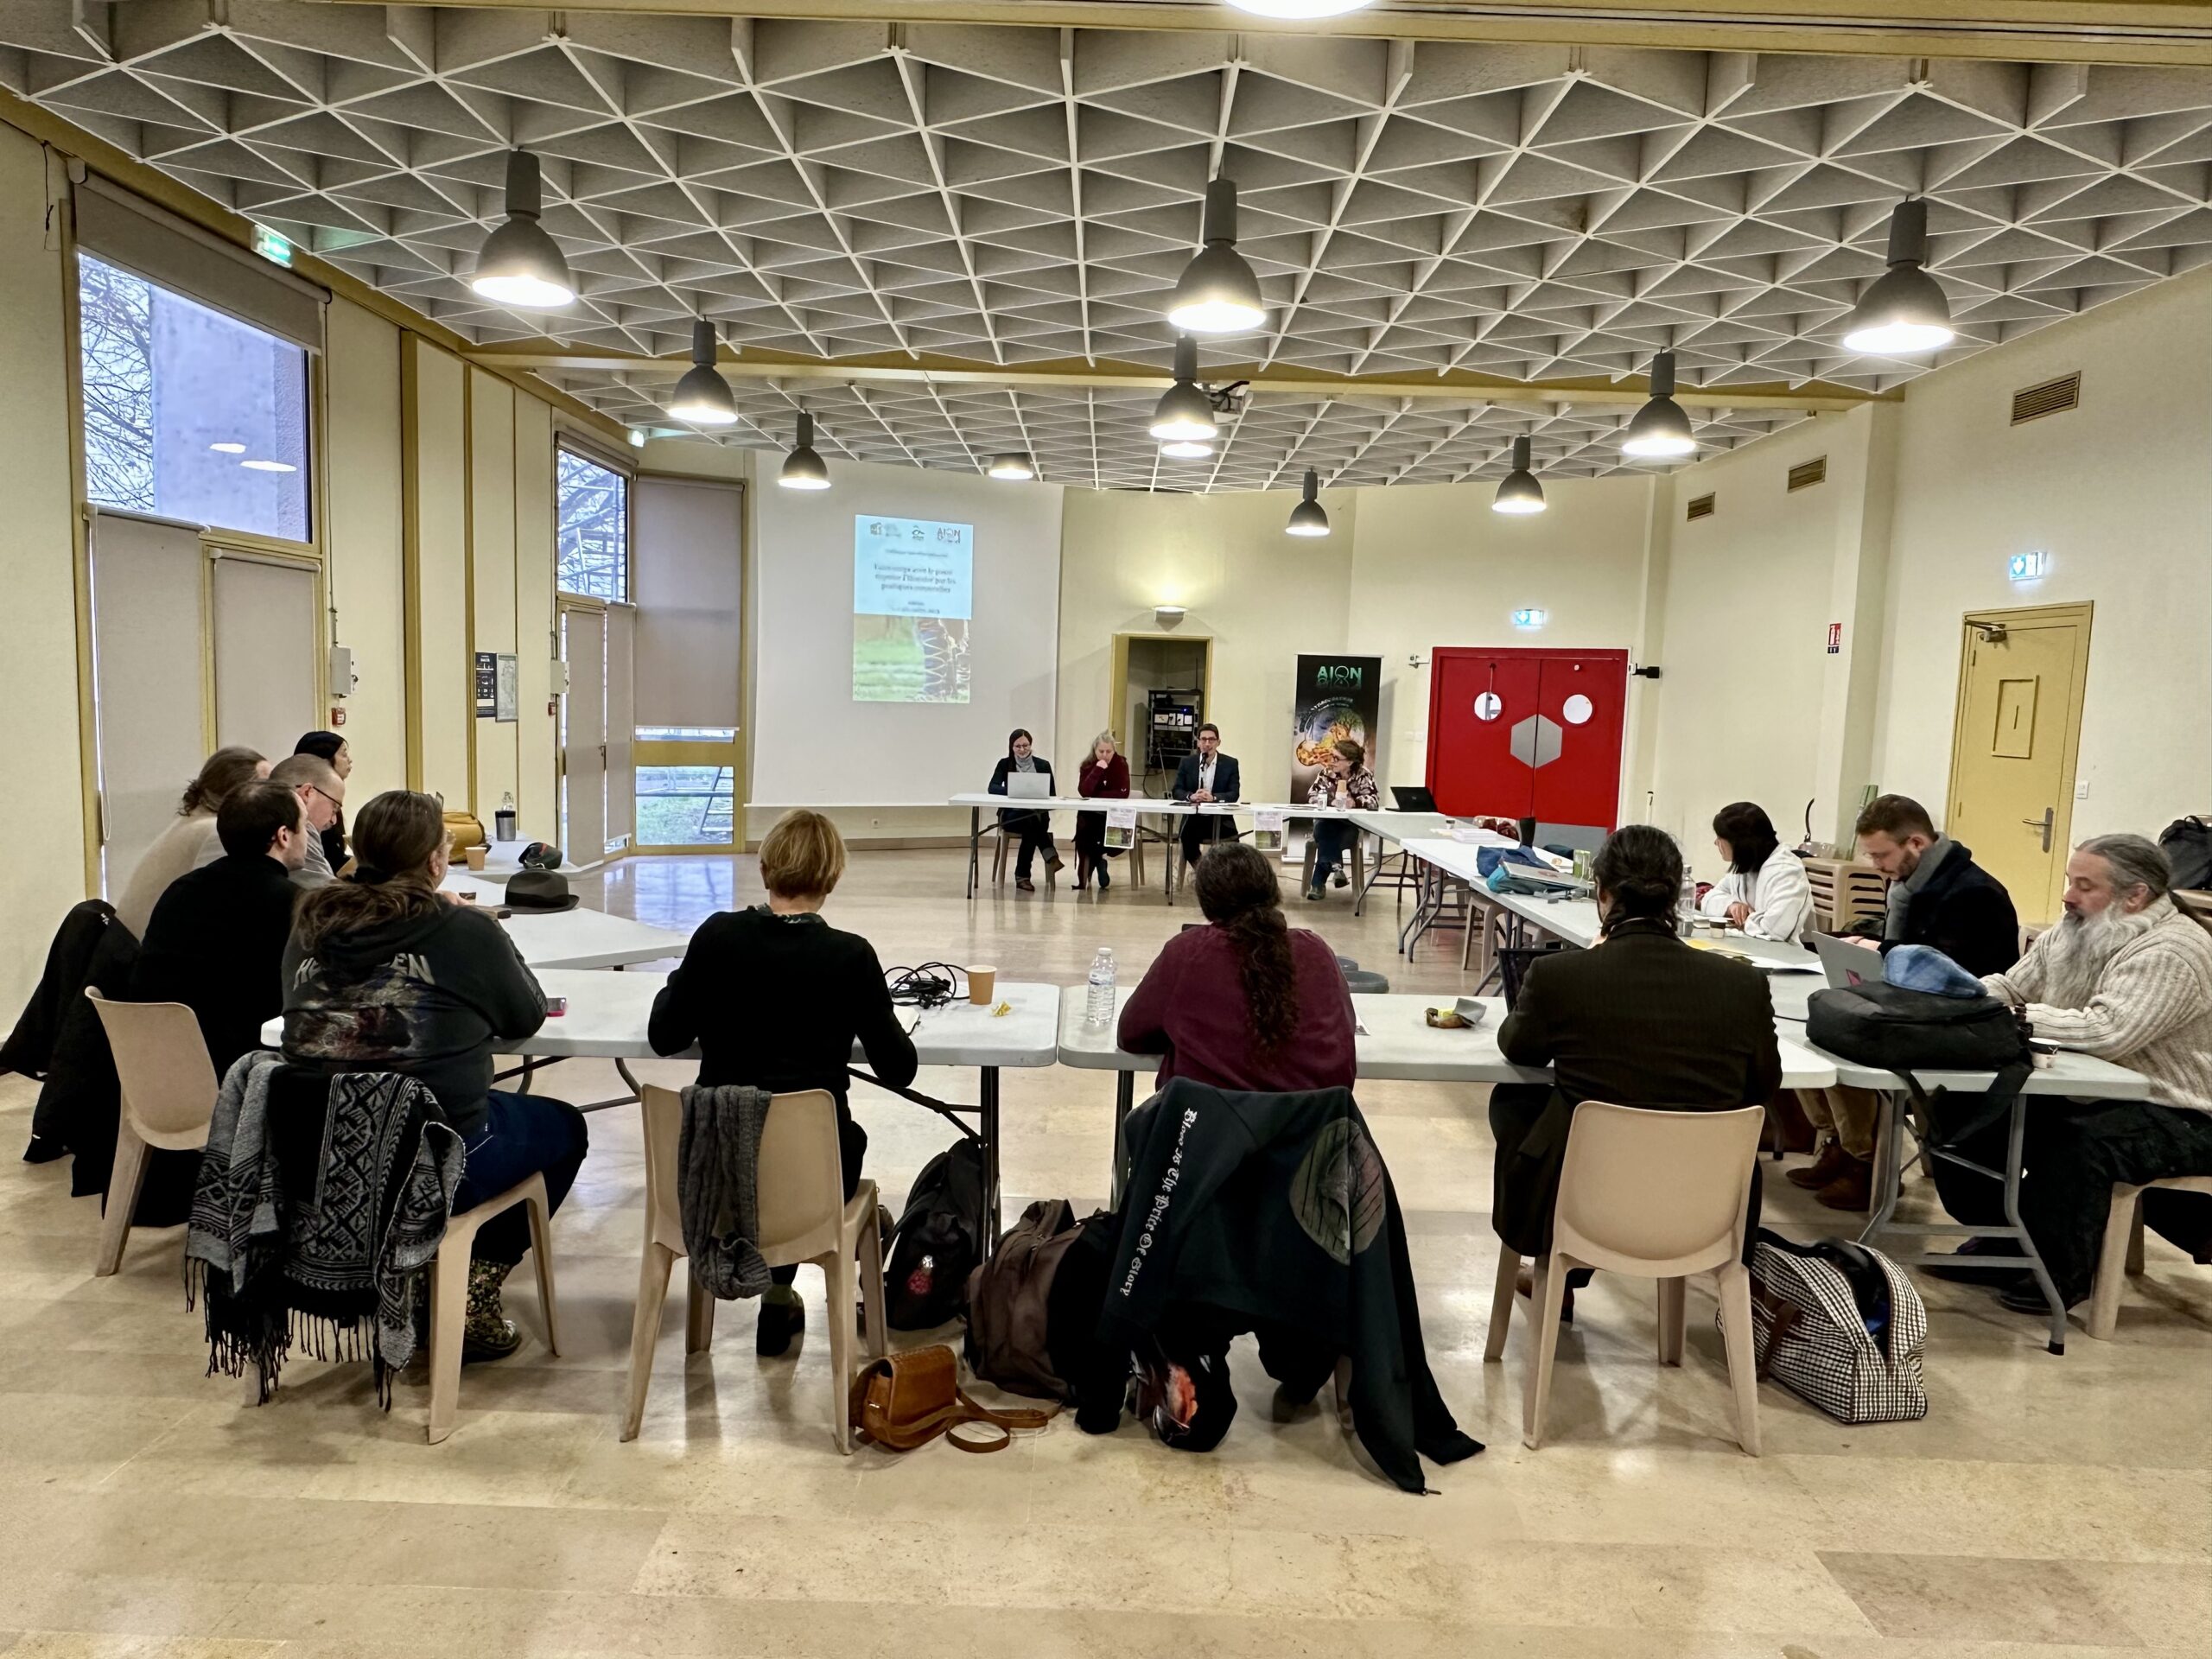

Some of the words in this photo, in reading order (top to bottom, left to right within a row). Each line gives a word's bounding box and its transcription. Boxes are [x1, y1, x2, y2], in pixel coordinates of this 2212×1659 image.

[1317, 665, 1362, 684] AION
[1161, 1167, 1179, 1192] The
[1145, 1195, 1170, 1231] Price
[1136, 1233, 1153, 1256] Of
[1120, 1256, 1142, 1296] Glory
